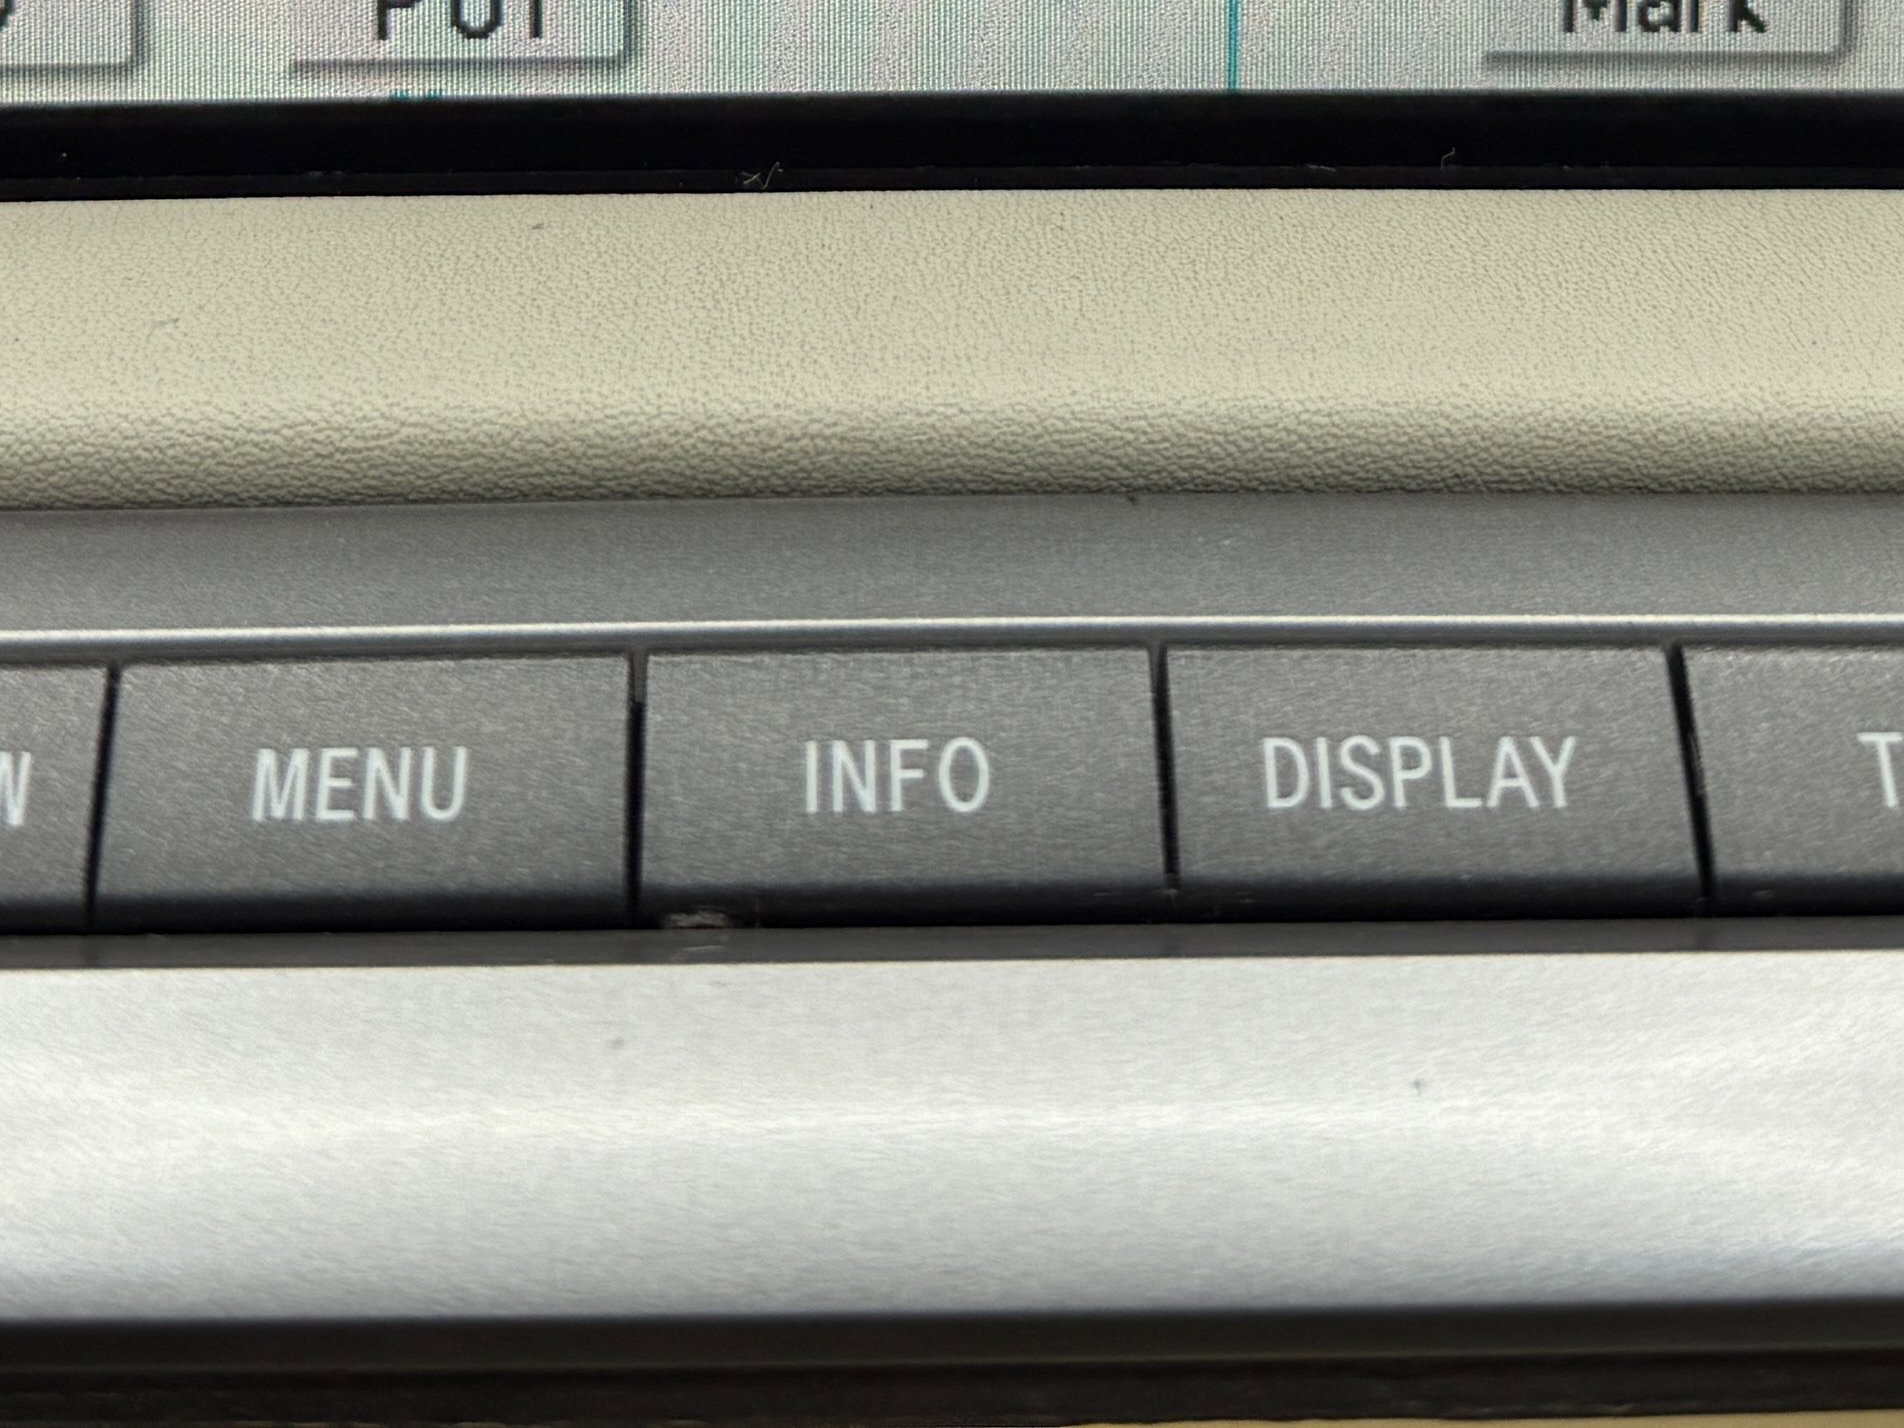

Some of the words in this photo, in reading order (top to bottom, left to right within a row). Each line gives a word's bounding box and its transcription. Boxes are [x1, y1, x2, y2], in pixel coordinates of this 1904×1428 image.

[251, 745, 470, 822] MENU
[803, 736, 992, 815] INFO
[1262, 734, 1578, 812] DISPLAY
